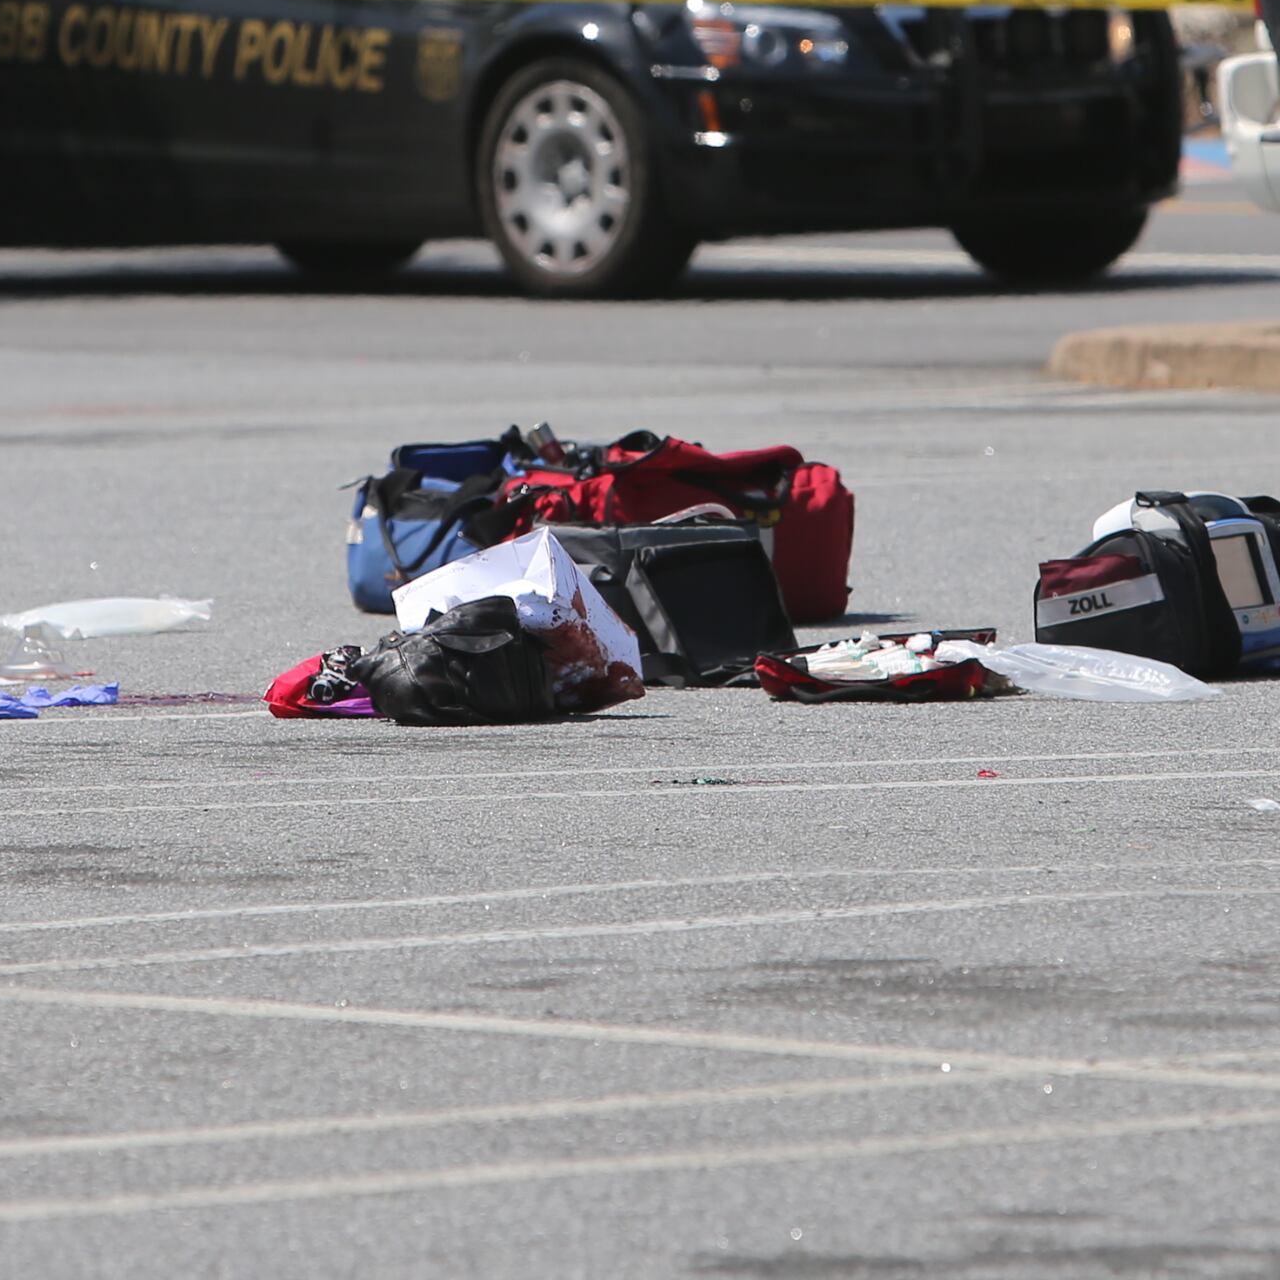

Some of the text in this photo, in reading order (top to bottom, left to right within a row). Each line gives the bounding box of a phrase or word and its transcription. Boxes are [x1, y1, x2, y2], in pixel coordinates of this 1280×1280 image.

[58, 3, 227, 79] COUNTY
[234, 18, 390, 91] POLICE
[1068, 593, 1113, 615] ZOLL
